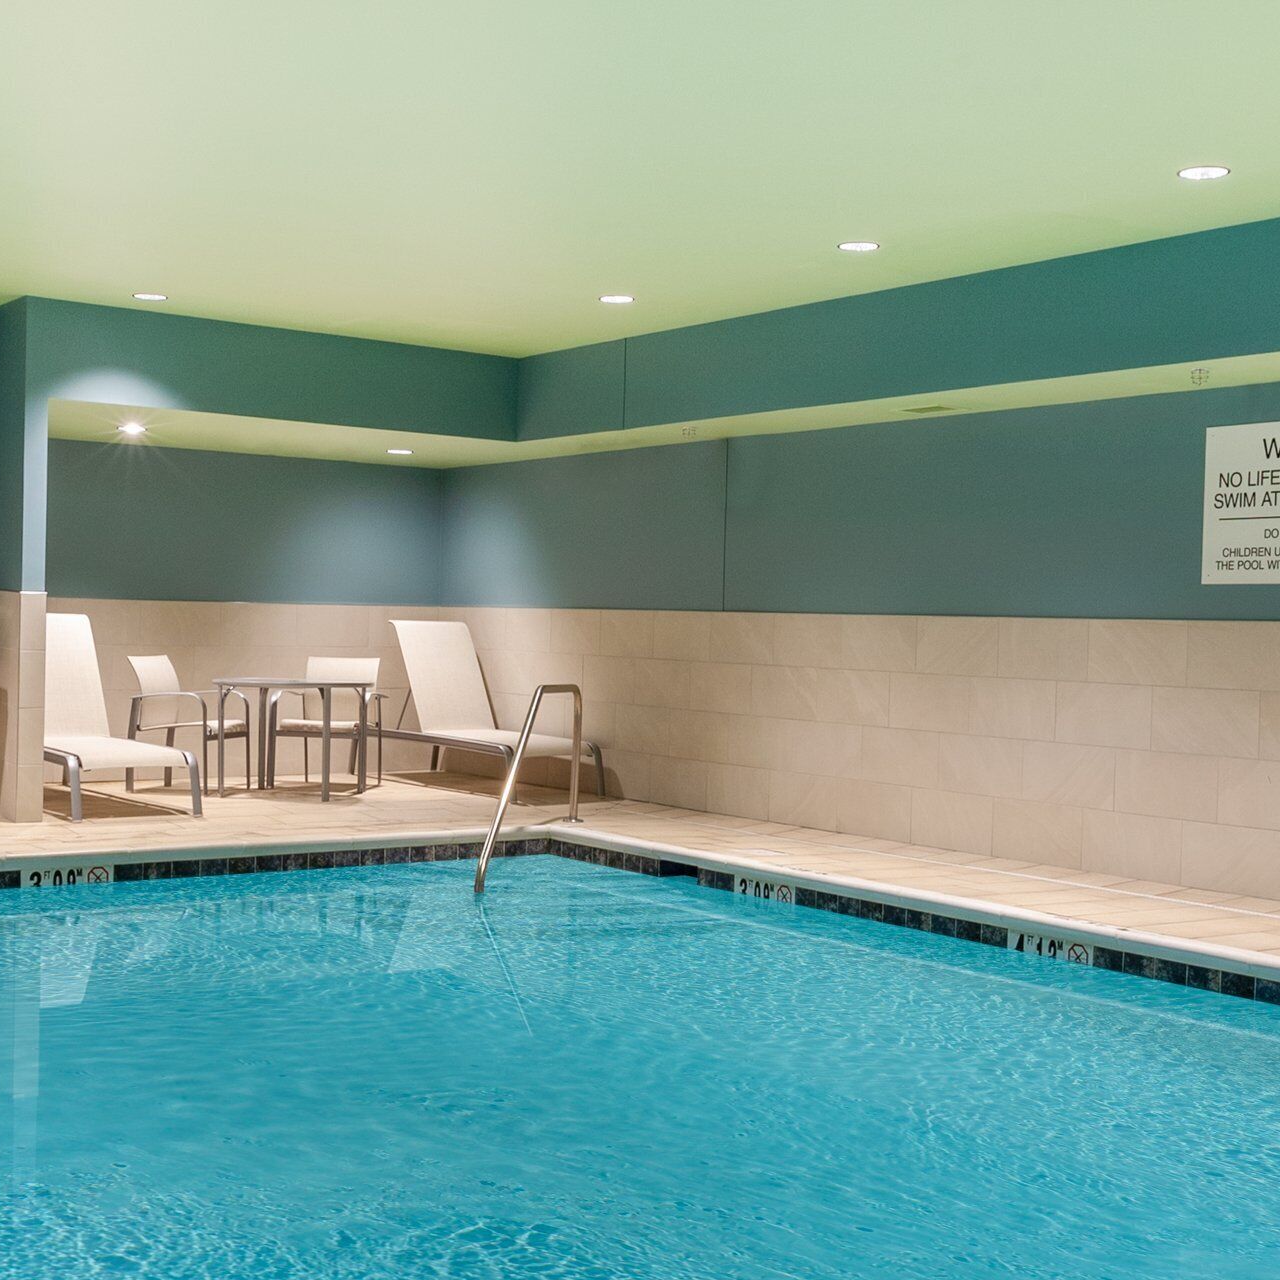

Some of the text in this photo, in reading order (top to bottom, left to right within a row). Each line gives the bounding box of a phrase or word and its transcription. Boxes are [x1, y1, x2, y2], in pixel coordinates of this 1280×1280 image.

[1219, 472, 1243, 488] NO
[1214, 493, 1256, 509] SWIM
[1261, 491, 1280, 507] AT
[1264, 529, 1279, 539] DO
[1222, 547, 1271, 558] CHILDREN
[1216, 560, 1234, 570] THE
[1237, 560, 1264, 570] POOL
